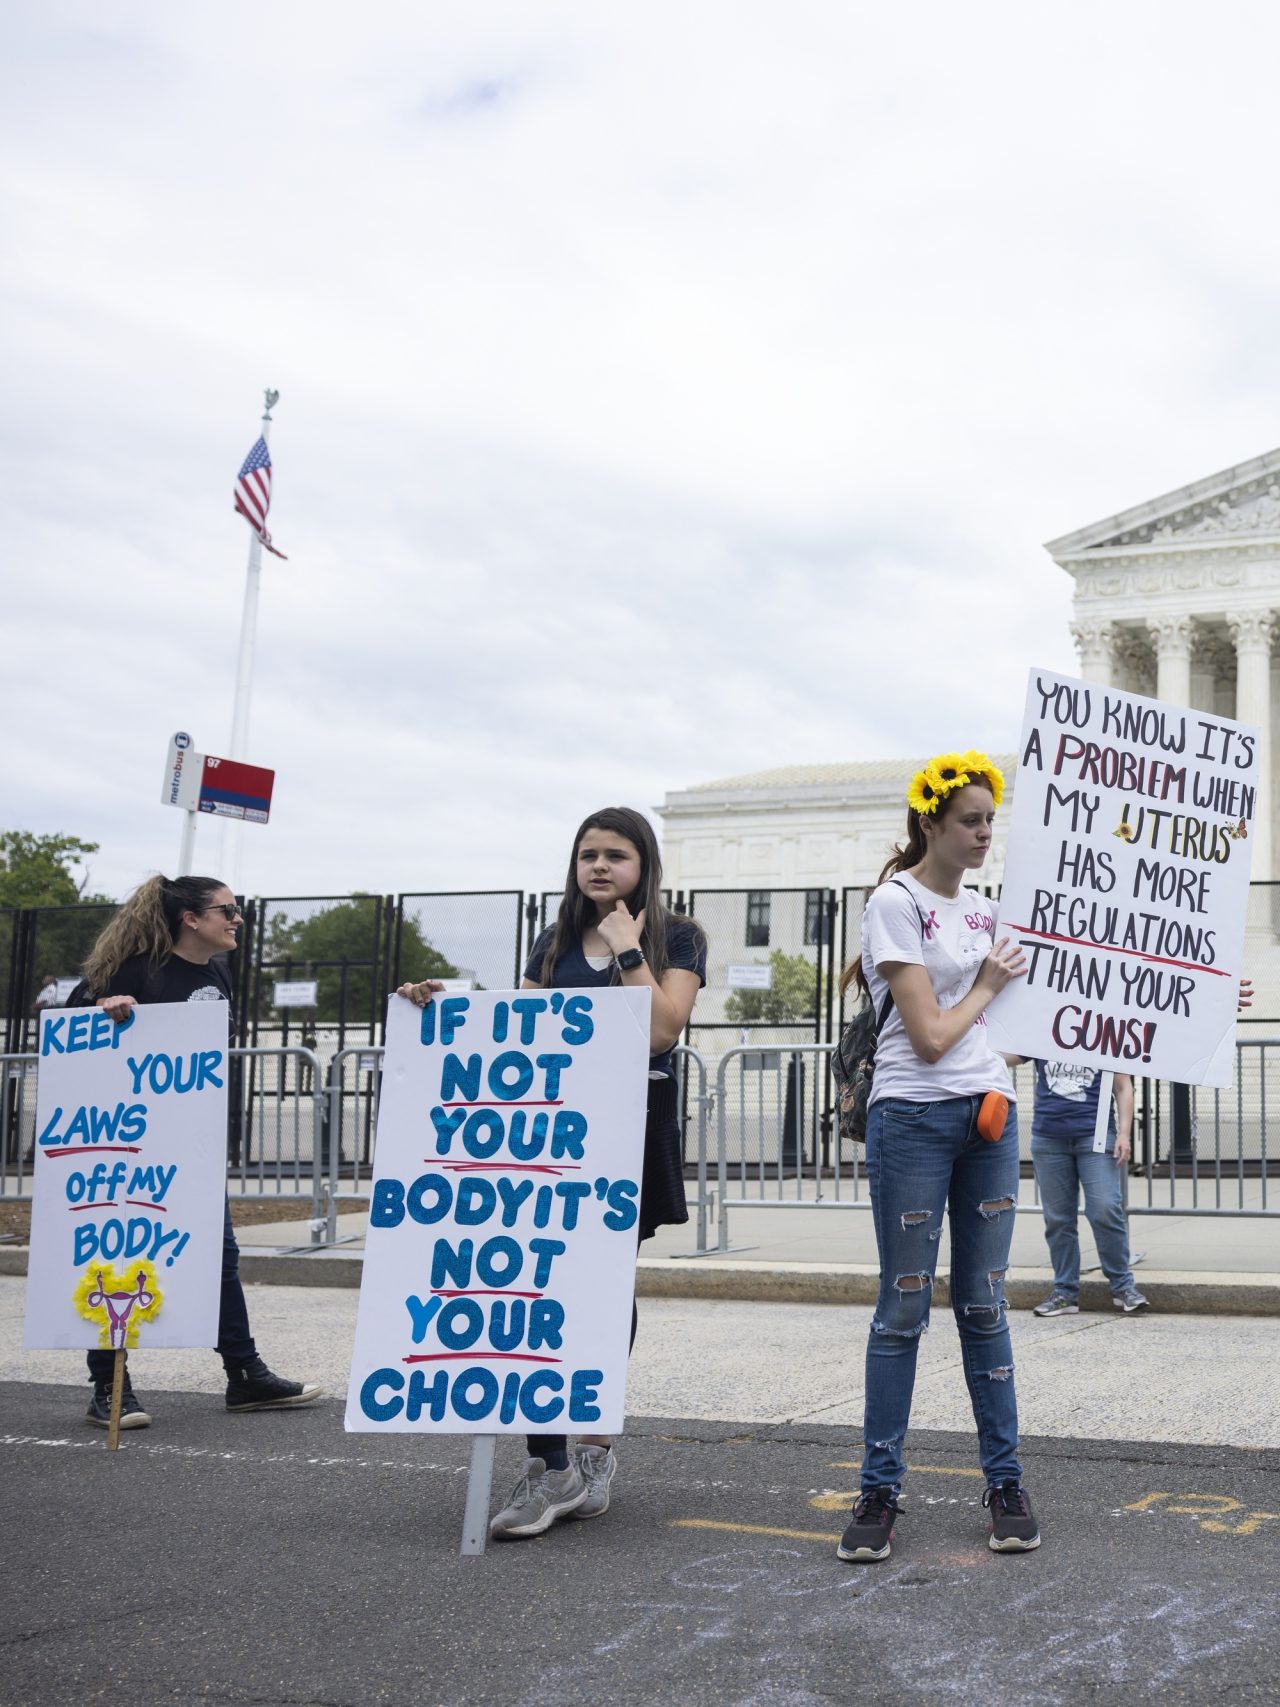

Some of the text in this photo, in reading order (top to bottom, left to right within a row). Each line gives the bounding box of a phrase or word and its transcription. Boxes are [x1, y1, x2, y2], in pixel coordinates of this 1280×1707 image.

[1036, 676, 1256, 770] YOU KNOW IT'S
[170, 751, 184, 804] metrobus
[1022, 728, 1256, 820] A PROBLEM WHEN
[1043, 783, 1233, 865] MY UTERUS
[1056, 840, 1213, 914] HAS MORE
[1030, 889, 1217, 966] REGULATIONS
[1018, 940, 1196, 1018] THAN YOUR
[41, 1008, 136, 1057] KEEP
[420, 992, 595, 1046] IF IT'S
[1051, 1004, 1158, 1063] GUNS!
[127, 1050, 224, 1095] YOUR
[440, 1050, 573, 1102] NOT
[39, 1102, 148, 1146] LAWS
[430, 1105, 588, 1161] YOUR
[66, 1162, 127, 1202] off
[73, 1217, 191, 1268] BODY!
[430, 1235, 566, 1289] NOT
[405, 1295, 566, 1352] YOUR
[360, 1366, 604, 1425] CHOICE
